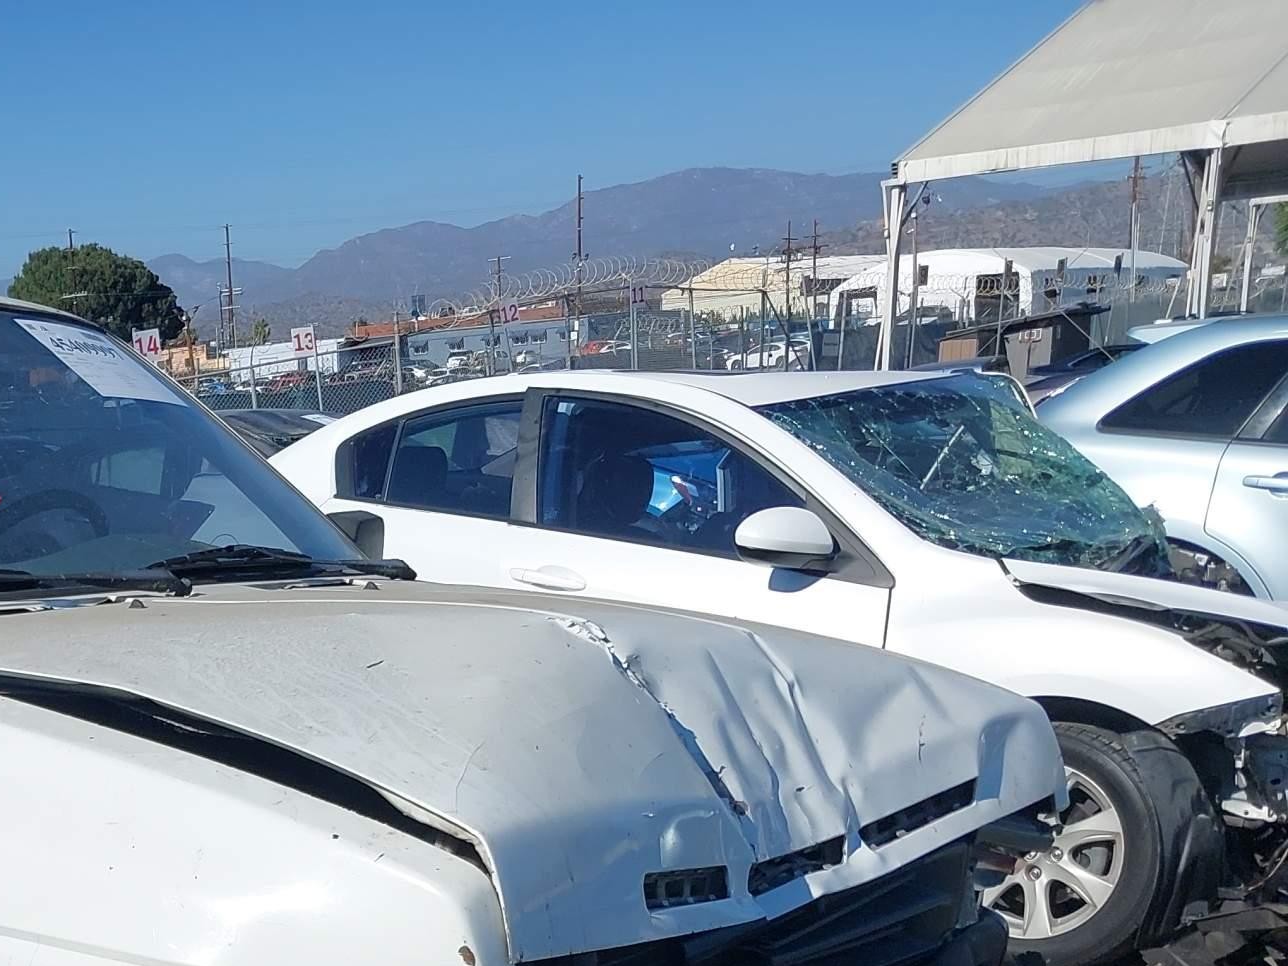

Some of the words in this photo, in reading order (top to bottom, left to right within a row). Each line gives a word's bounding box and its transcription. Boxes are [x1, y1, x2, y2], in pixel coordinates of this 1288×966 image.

[631, 286, 645, 304] 11
[500, 303, 520, 324] 12
[134, 335, 160, 357] 14
[293, 332, 315, 352] 13
